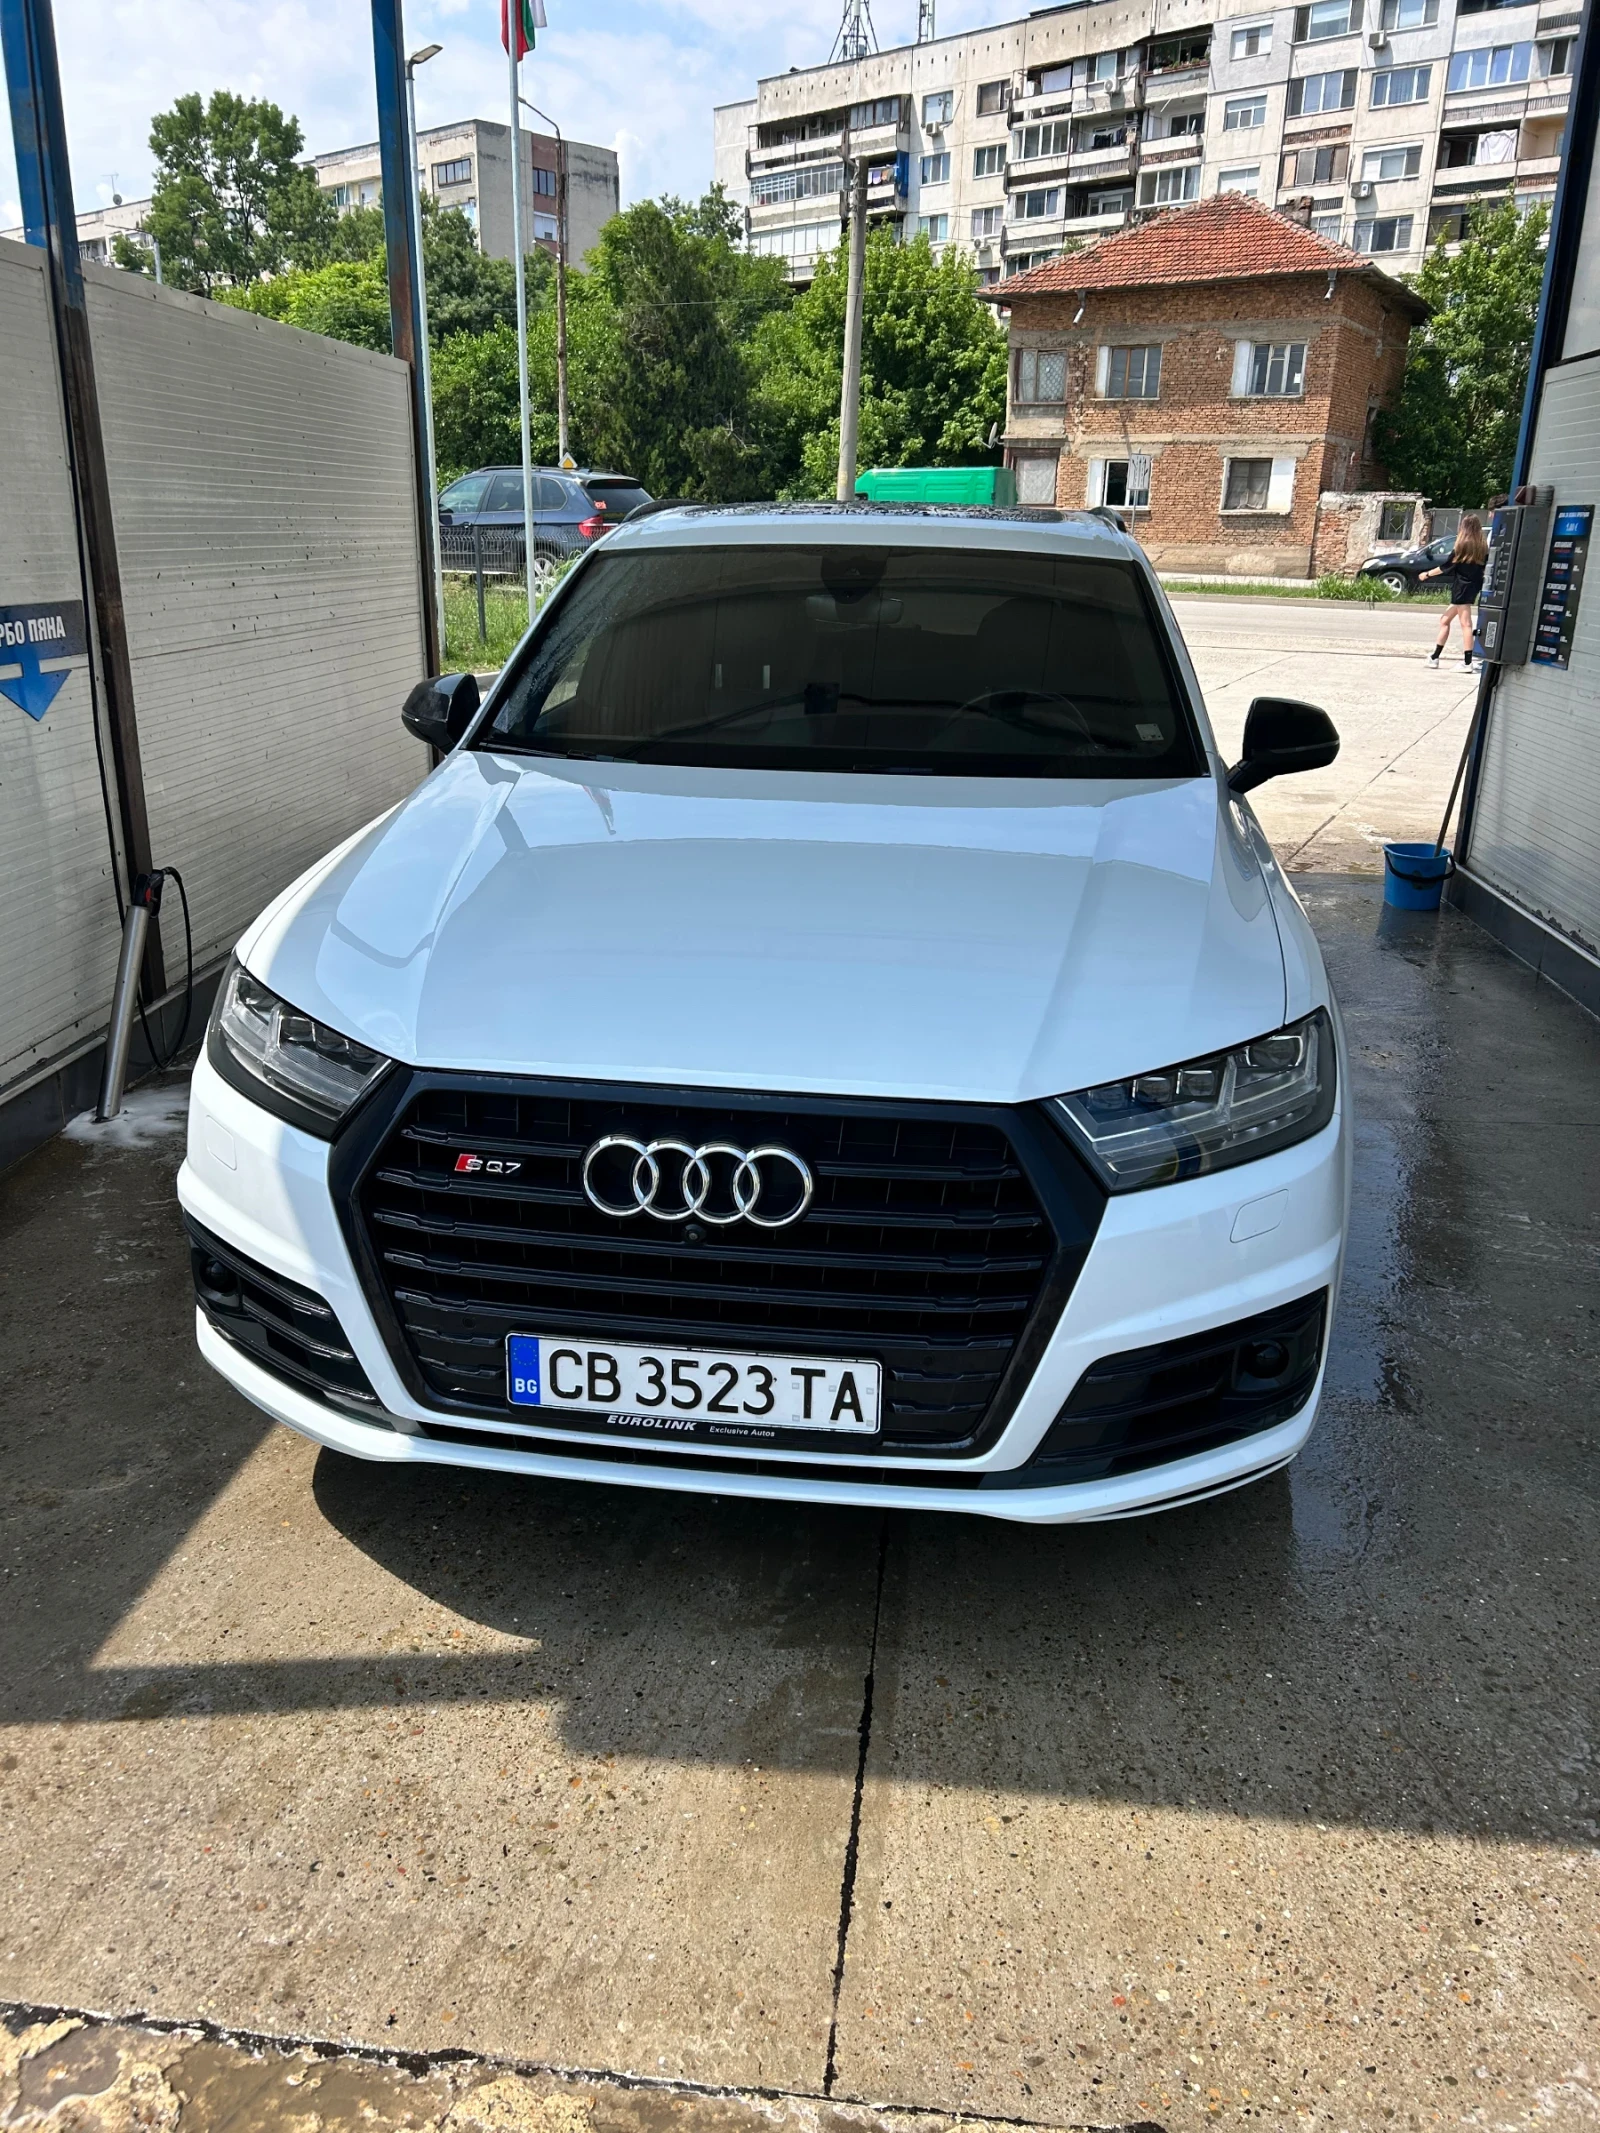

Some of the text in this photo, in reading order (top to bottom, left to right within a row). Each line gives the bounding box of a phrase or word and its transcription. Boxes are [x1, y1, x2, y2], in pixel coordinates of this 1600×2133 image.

[27, 616, 66, 642] ПЯНА
[465, 1158, 521, 1173] SQ7
[514, 1378, 538, 1394] BG
[549, 1348, 864, 1422] CB 3523 TA
[606, 1414, 775, 1438] EUROLINK Exclusive Autos
